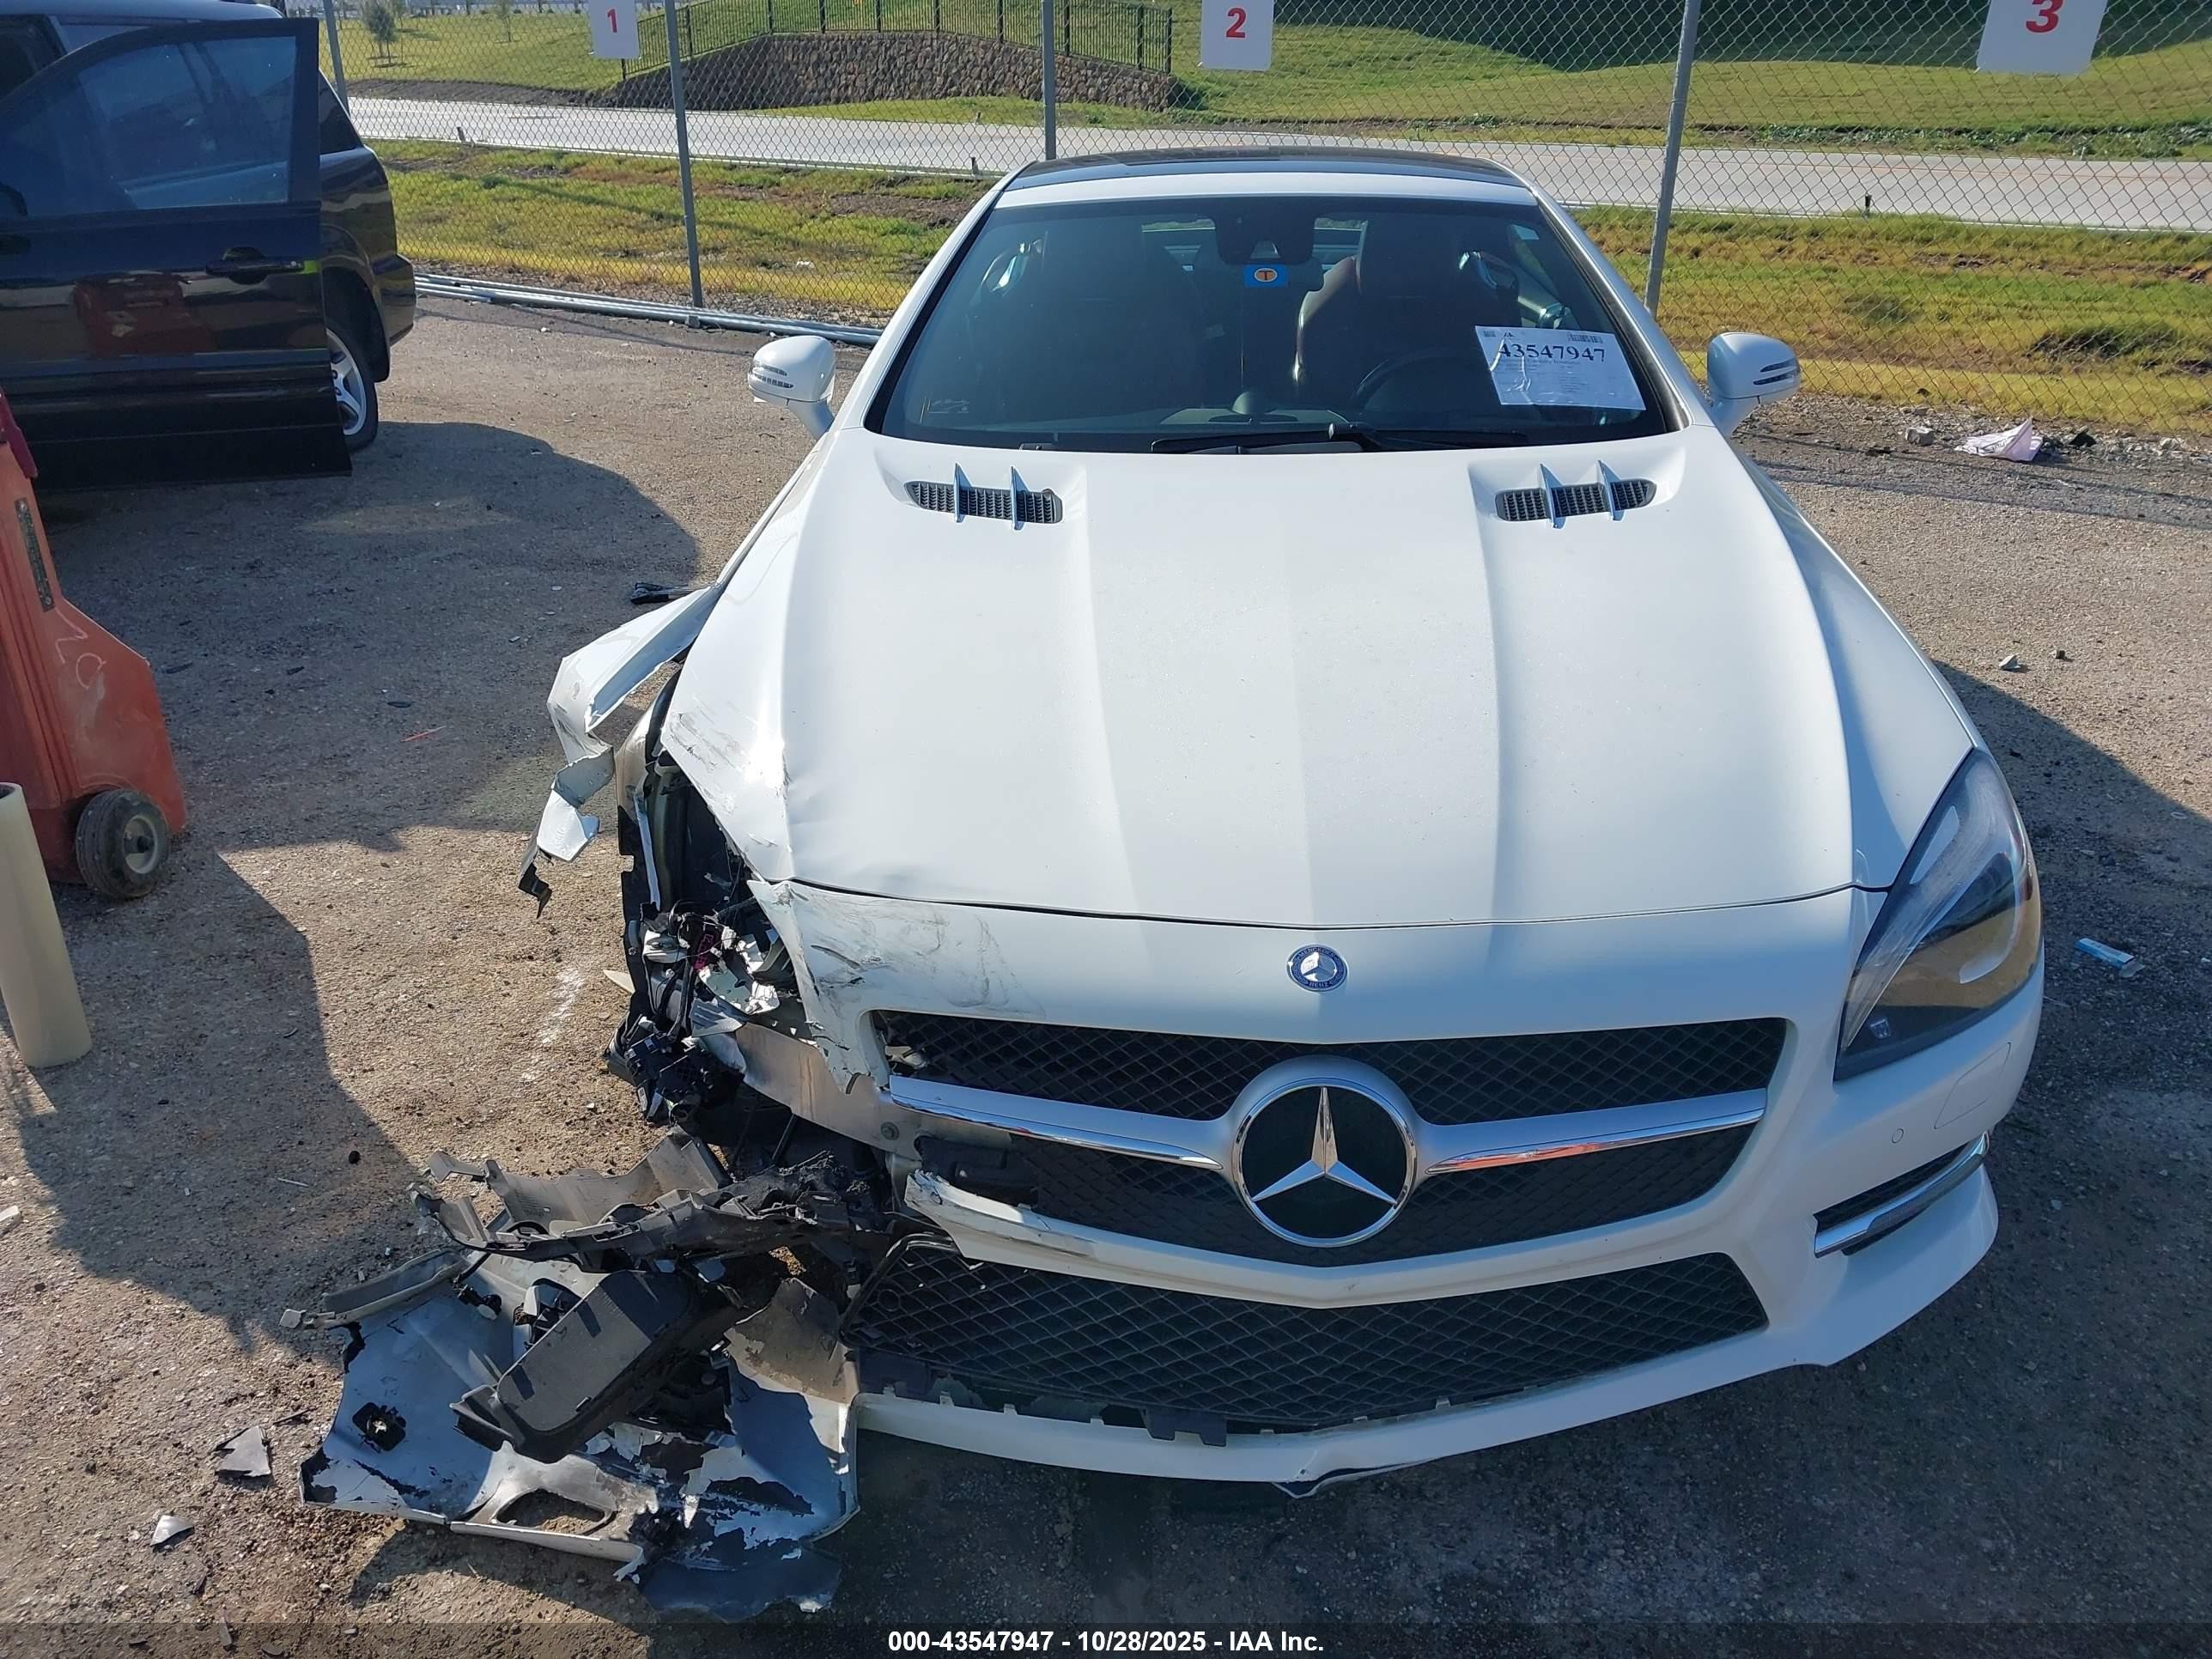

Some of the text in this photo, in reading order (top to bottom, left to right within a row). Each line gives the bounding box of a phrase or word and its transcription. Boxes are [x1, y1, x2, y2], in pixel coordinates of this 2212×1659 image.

[606, 8, 617, 33] 1
[1225, 7, 1247, 39] 2
[2026, 0, 2063, 33] 3
[1498, 343, 1606, 362] 43547947
